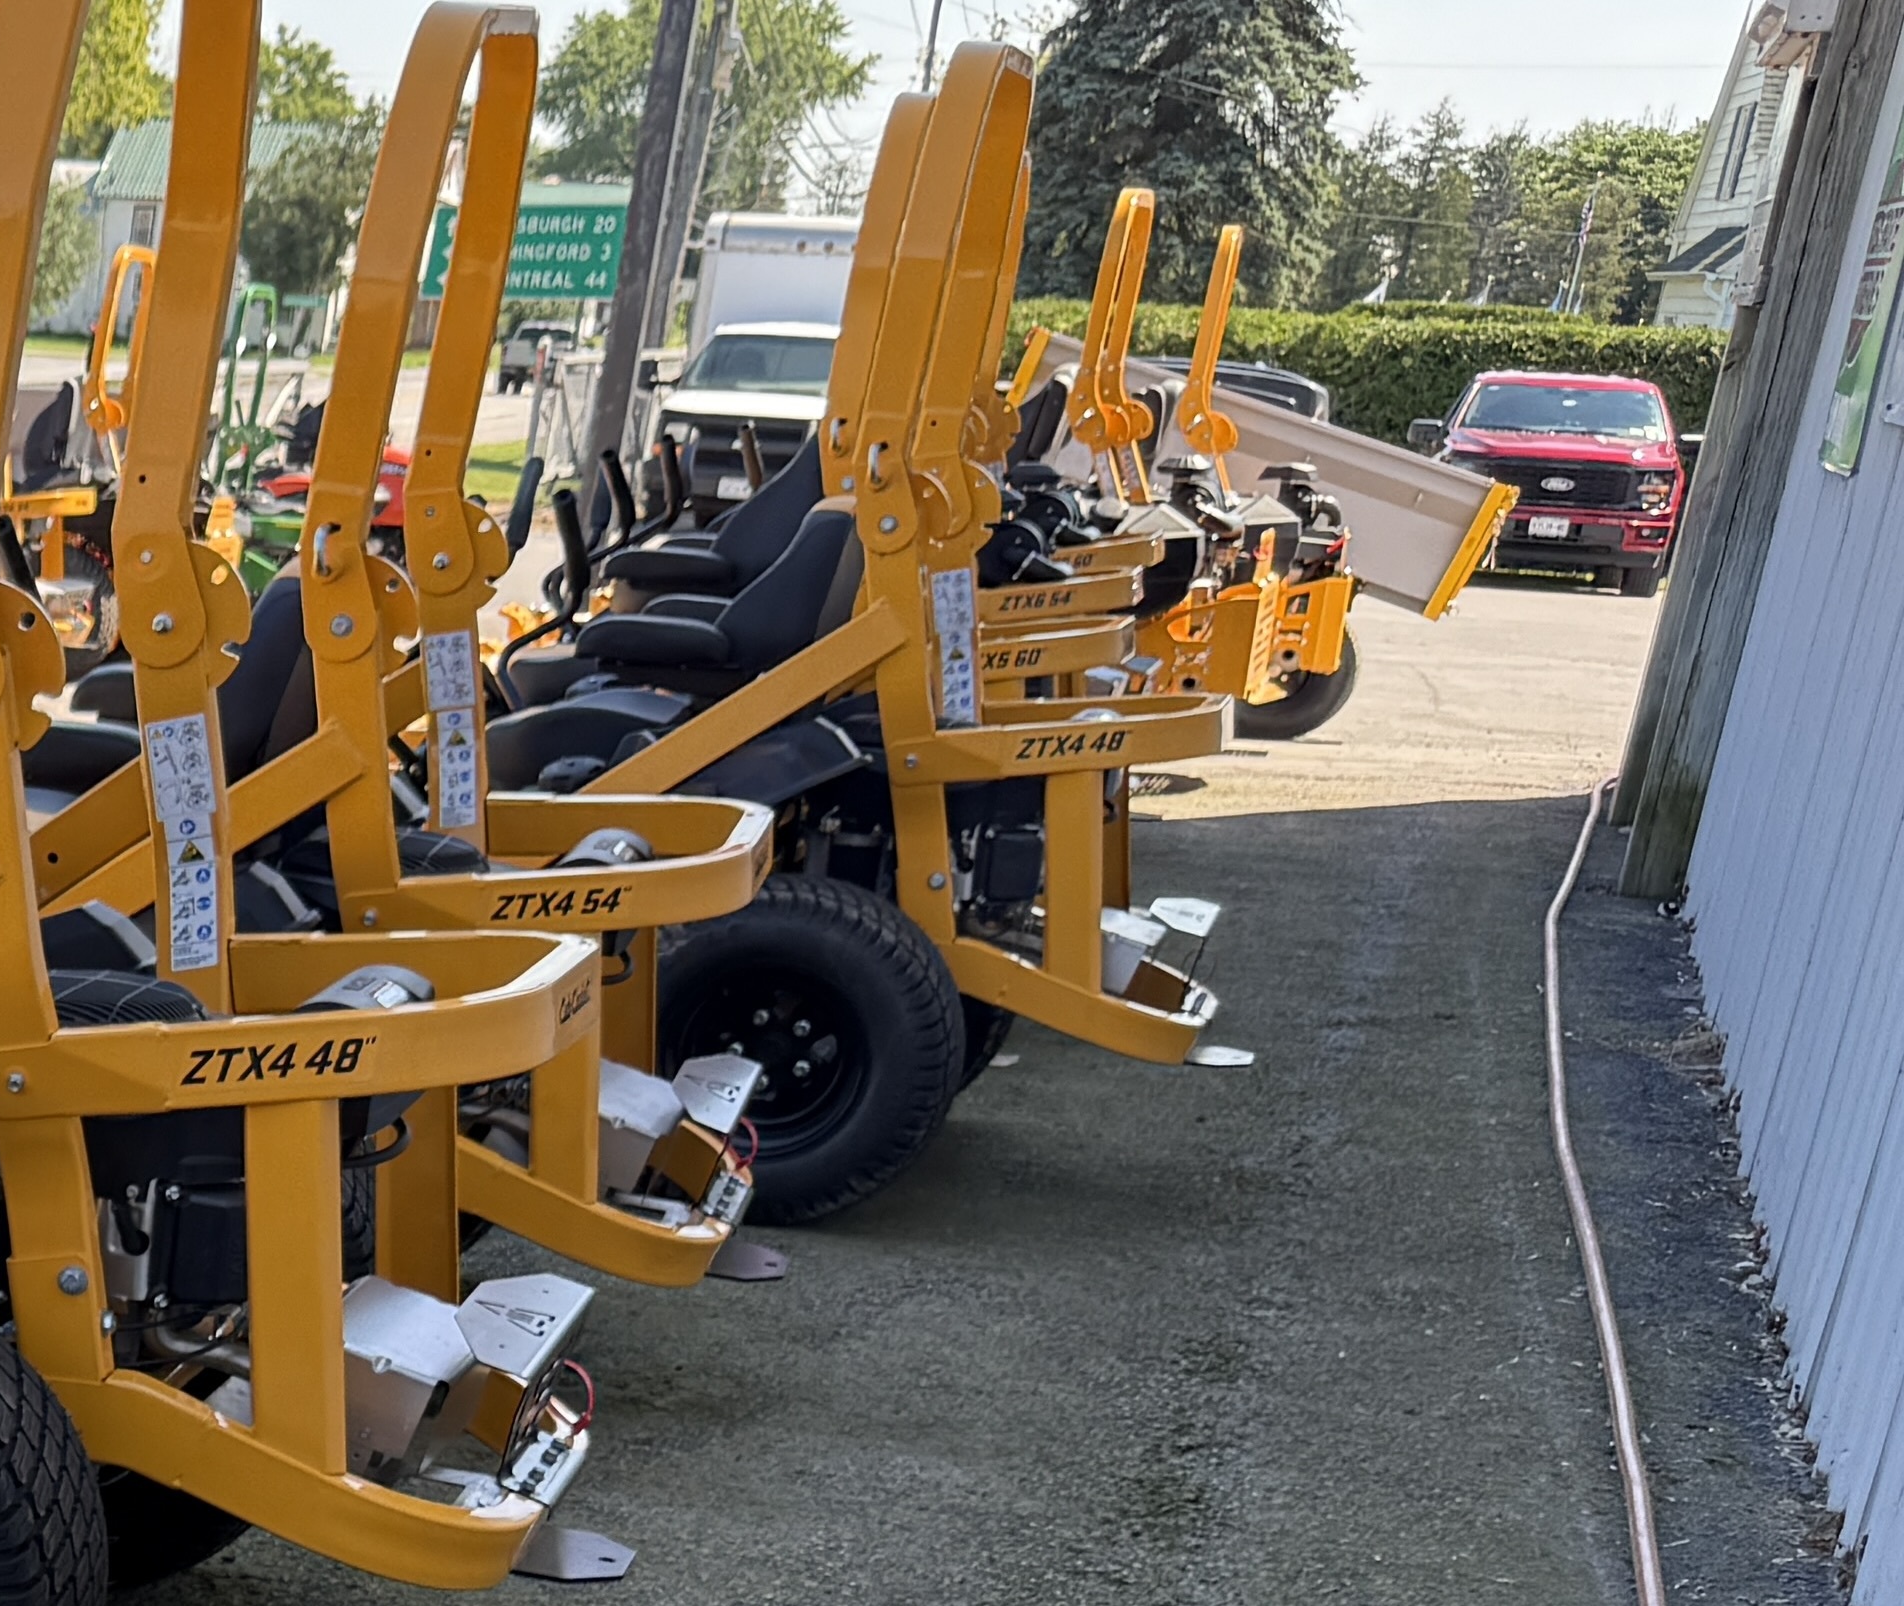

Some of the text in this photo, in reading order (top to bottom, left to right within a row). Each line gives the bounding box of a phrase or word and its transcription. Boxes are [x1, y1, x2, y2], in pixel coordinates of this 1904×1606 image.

[517, 214, 617, 235] SBURGH 20
[510, 242, 612, 262] INGFORD 3
[506, 269, 608, 290] NTREAL 44
[1015, 733, 1085, 762] ZTX4
[490, 886, 633, 922] ZTX4 54"
[181, 1036, 377, 1086] ZTX4 48"
